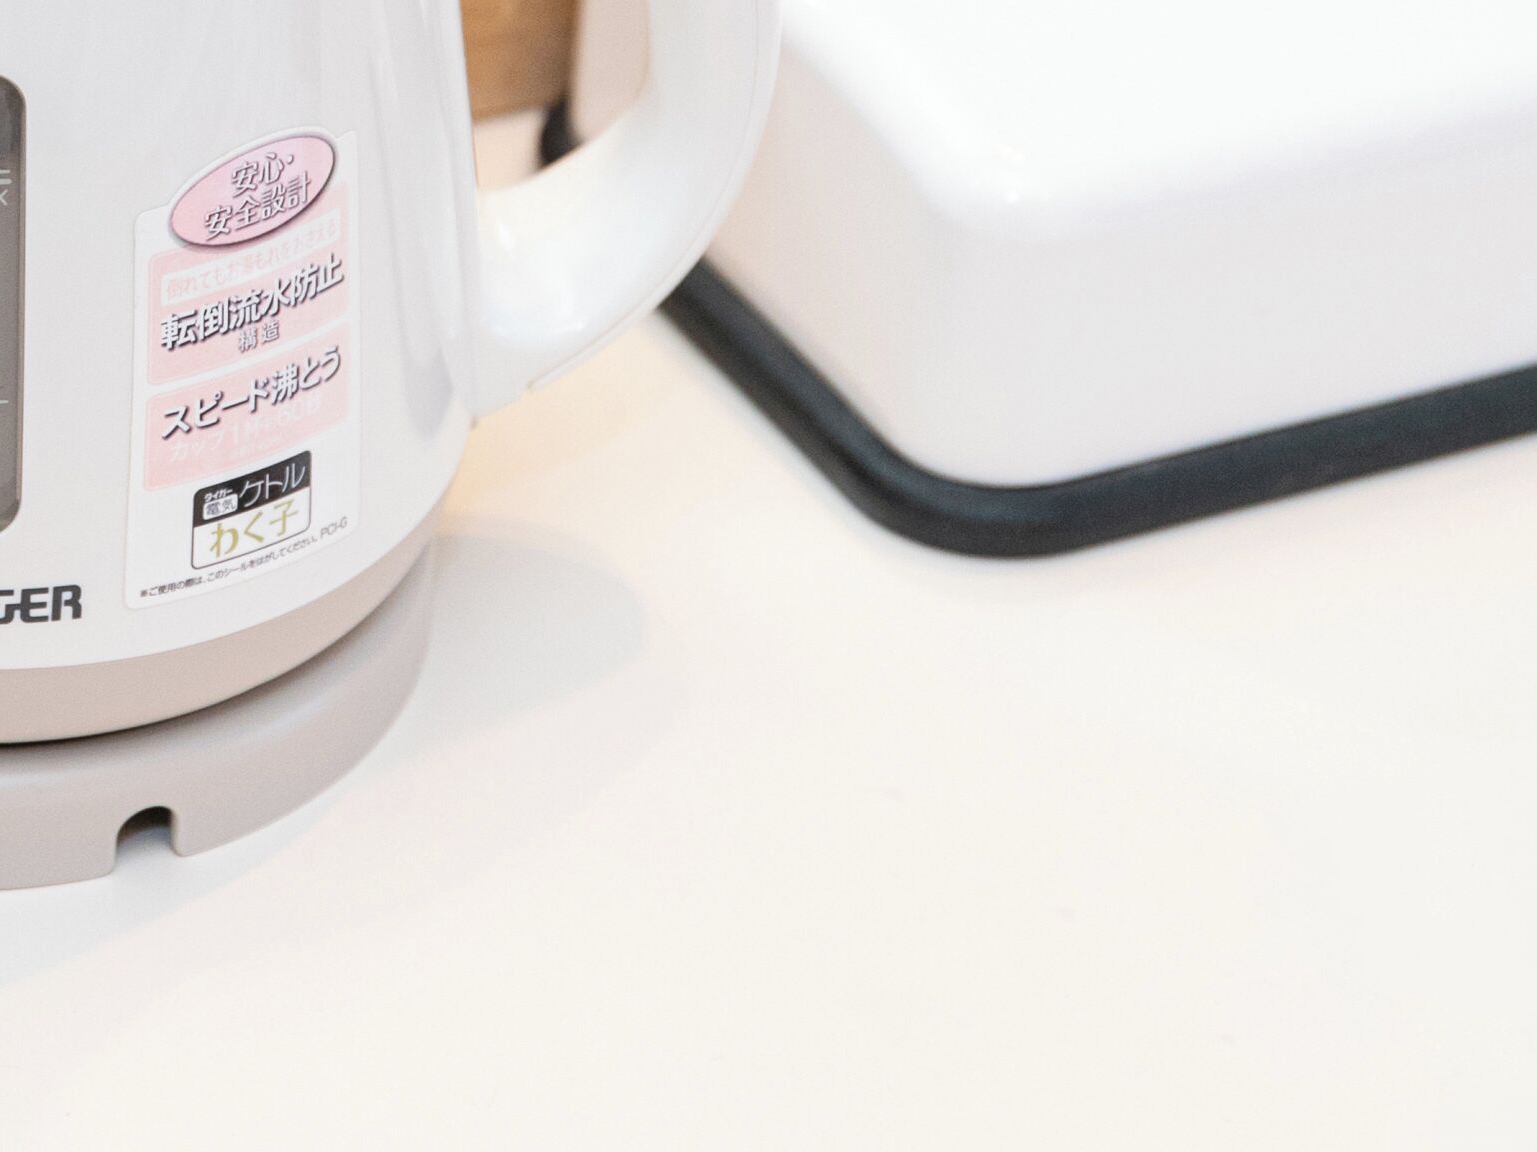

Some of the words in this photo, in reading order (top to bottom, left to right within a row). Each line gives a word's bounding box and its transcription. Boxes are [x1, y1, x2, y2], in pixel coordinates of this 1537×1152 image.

[204, 170, 312, 241] 安全設計
[160, 252, 344, 351] 転倒流水防止
[237, 323, 280, 352] 構造
[162, 345, 342, 441] スピード沸とう
[203, 488, 234, 503] タイガー
[206, 498, 236, 516] 電気
[239, 463, 306, 508] ケトル
[210, 498, 299, 558] わく子
